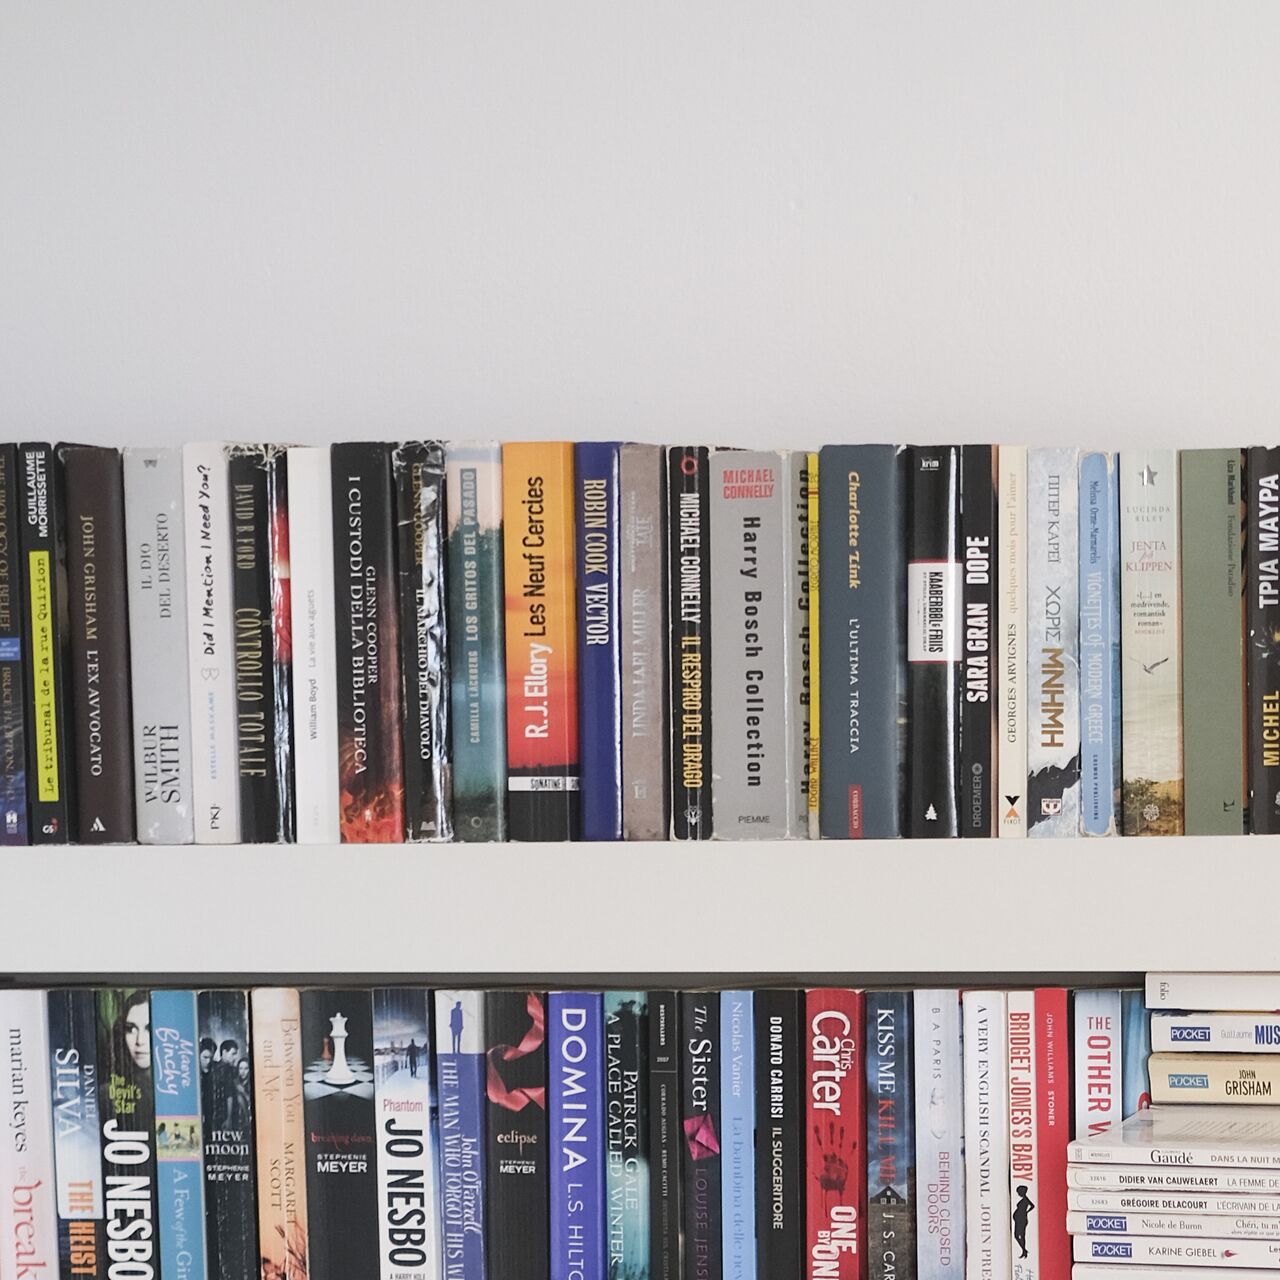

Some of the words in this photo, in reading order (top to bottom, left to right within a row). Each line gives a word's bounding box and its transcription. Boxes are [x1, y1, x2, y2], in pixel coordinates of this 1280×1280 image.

[26, 452, 38, 525] GUILLAUME
[36, 451, 48, 537] MORRISSETTE
[462, 471, 476, 526] PASADO
[723, 469, 775, 484] MICHAEL
[723, 484, 774, 500] CONNELLY
[584, 479, 607, 528] ROBIN
[680, 493, 699, 553] MICHAEL
[848, 471, 859, 547] Charlotte
[80, 516, 94, 556] JOHN
[348, 489, 362, 578] CUSTODI
[464, 529, 476, 555] DEL
[585, 532, 608, 574] COOK
[740, 517, 761, 579] Harry
[464, 559, 478, 612] GRITOS
[524, 553, 545, 599] Neuf
[966, 536, 989, 585] DOPE
[1126, 562, 1172, 571] KLIPPEN
[84, 563, 97, 639] GRISHAM
[350, 583, 363, 650] DELLA
[586, 583, 609, 646] VECTOR
[681, 556, 700, 624] CONNELLY
[464, 616, 478, 641] LOS
[524, 604, 545, 637] Les
[744, 591, 762, 657] Bosch
[966, 604, 989, 649] GRAN
[235, 608, 264, 701] CONTROLLO
[525, 643, 553, 696] Ellory
[966, 653, 989, 702] SARA
[1007, 624, 1016, 684] ARVIGNES
[88, 687, 102, 776] AVVOCATO
[352, 656, 367, 774] BIBLIOTECA
[745, 670, 764, 787] Collection
[1007, 689, 1016, 743] GEORGES
[1263, 691, 1280, 767] MICHEL
[144, 725, 158, 803] WILBUR
[160, 725, 181, 803] SMITH
[237, 711, 266, 778] TOTALE
[738, 814, 770, 824] PIEMME
[695, 1006, 707, 1032] The
[770, 1016, 783, 1065] DONATO
[977, 1018, 988, 1055] VERY
[1009, 1012, 1031, 1071] BRIDGET
[1171, 1029, 1210, 1040] POCKET
[9, 1029, 24, 1095] marian
[608, 1033, 622, 1093] PLACE
[689, 1039, 712, 1111] Sister
[811, 1010, 850, 1115] Carter
[840, 1039, 855, 1070] Chris
[1239, 1070, 1256, 1079] JOHN
[561, 1008, 587, 1173] DOMINA
[770, 1068, 783, 1118] CARRISI
[978, 1061, 989, 1117] ENGLISH
[1010, 1075, 1032, 1140] JONES'S
[1225, 1081, 1272, 1096] GRISHAM
[9, 1101, 29, 1152] keyes
[103, 1119, 149, 1165] JO
[385, 1118, 423, 1158] JO
[608, 1101, 622, 1176] CALLED
[317, 1161, 368, 1173] MEYER
[979, 1122, 990, 1197] SCANDAL
[1012, 1144, 1033, 1182] BABY
[1119, 1176, 1145, 1185] DIDIER
[1147, 1176, 1163, 1185] VAN
[1166, 1177, 1218, 1186] CAUWELAERT
[1150, 1150, 1193, 1165] Gaudé
[12, 1180, 47, 1279] break
[387, 1169, 426, 1267] NESBO
[610, 1187, 625, 1265] WINTER
[817, 1231, 831, 1247] BY
[830, 1206, 857, 1255] ONE
[1087, 1218, 1126, 1230] POCKET
[1141, 1220, 1166, 1229] Nicole
[1168, 1221, 1177, 1229] de
[1179, 1222, 1202, 1230] Buron
[1148, 1247, 1182, 1256] KARINE
[1185, 1248, 1216, 1257] GIEBEL
